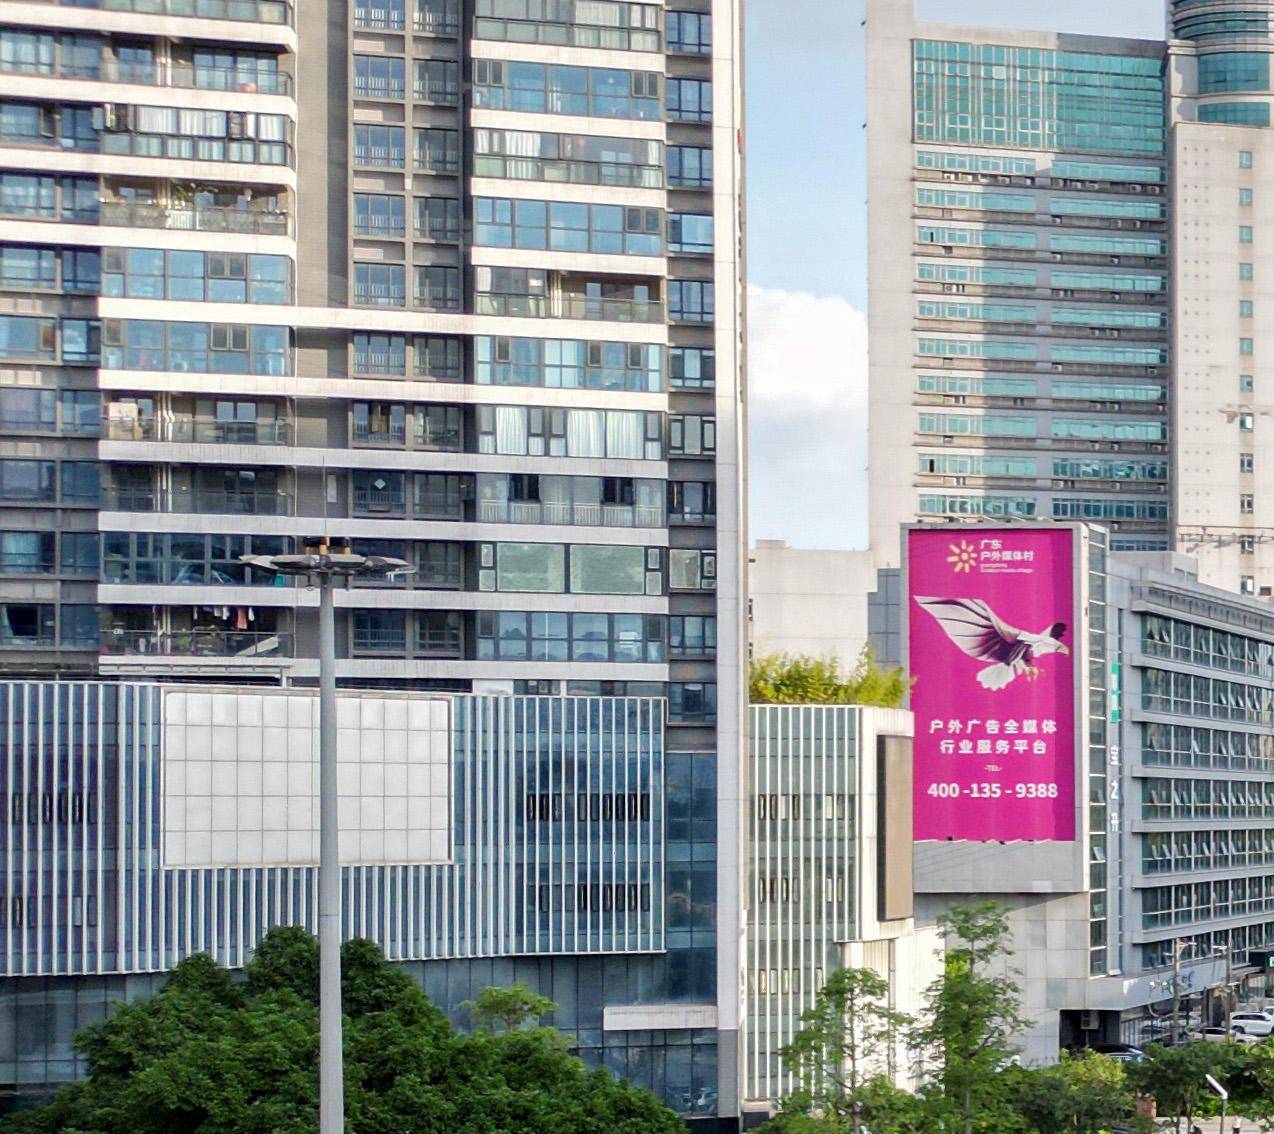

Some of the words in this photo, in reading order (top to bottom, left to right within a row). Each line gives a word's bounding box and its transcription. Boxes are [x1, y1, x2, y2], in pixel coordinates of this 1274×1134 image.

[928, 719, 1057, 734] 户外广告全媒体
[939, 739, 1047, 754] 行业服务平台
